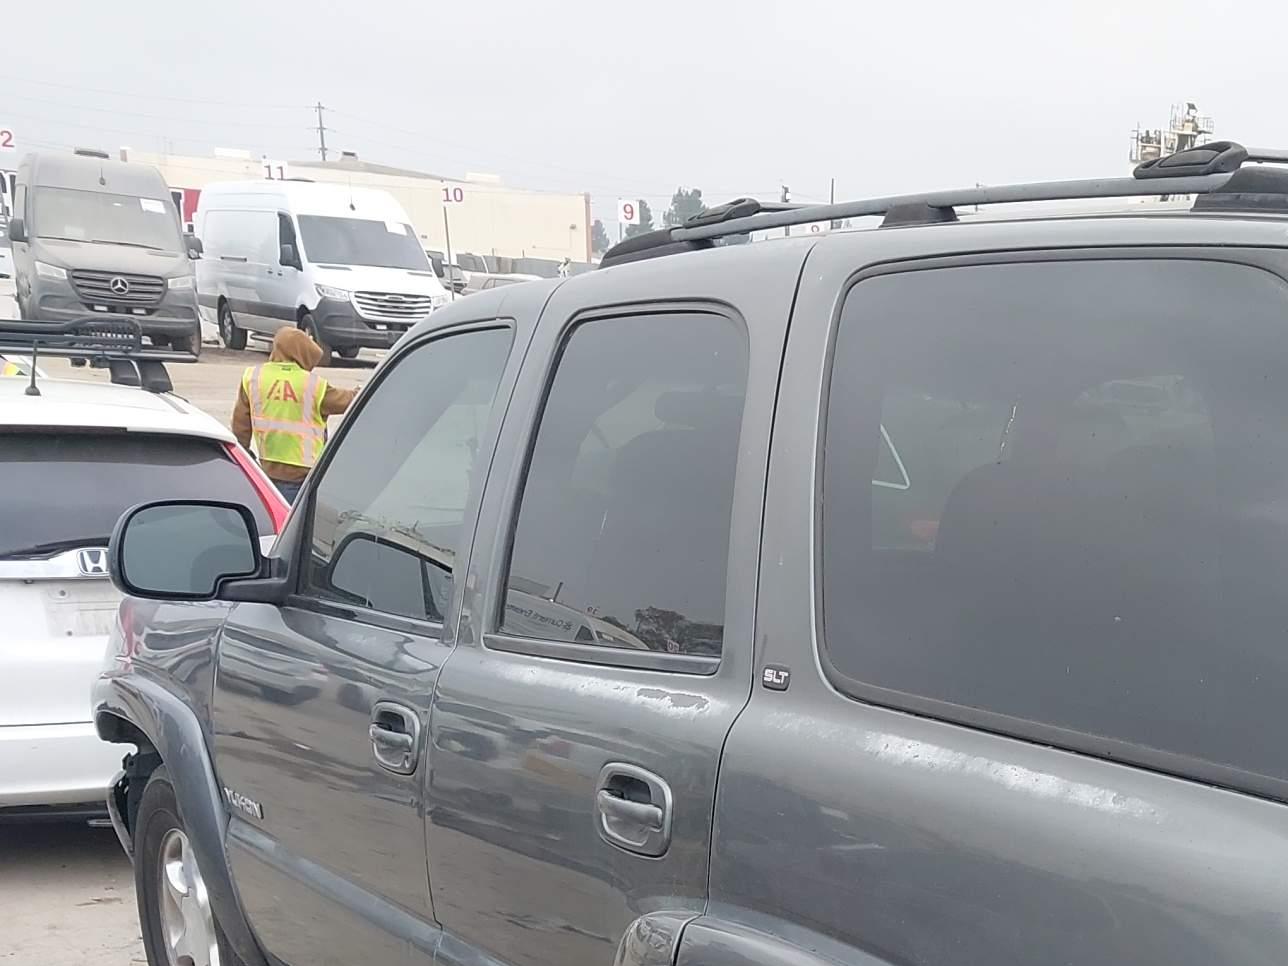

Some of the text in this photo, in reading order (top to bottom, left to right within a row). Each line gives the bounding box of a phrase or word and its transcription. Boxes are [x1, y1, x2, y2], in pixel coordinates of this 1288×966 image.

[263, 164, 284, 181] 11
[441, 187, 464, 203] 10
[623, 203, 634, 221] 9
[763, 668, 789, 684] SLT
